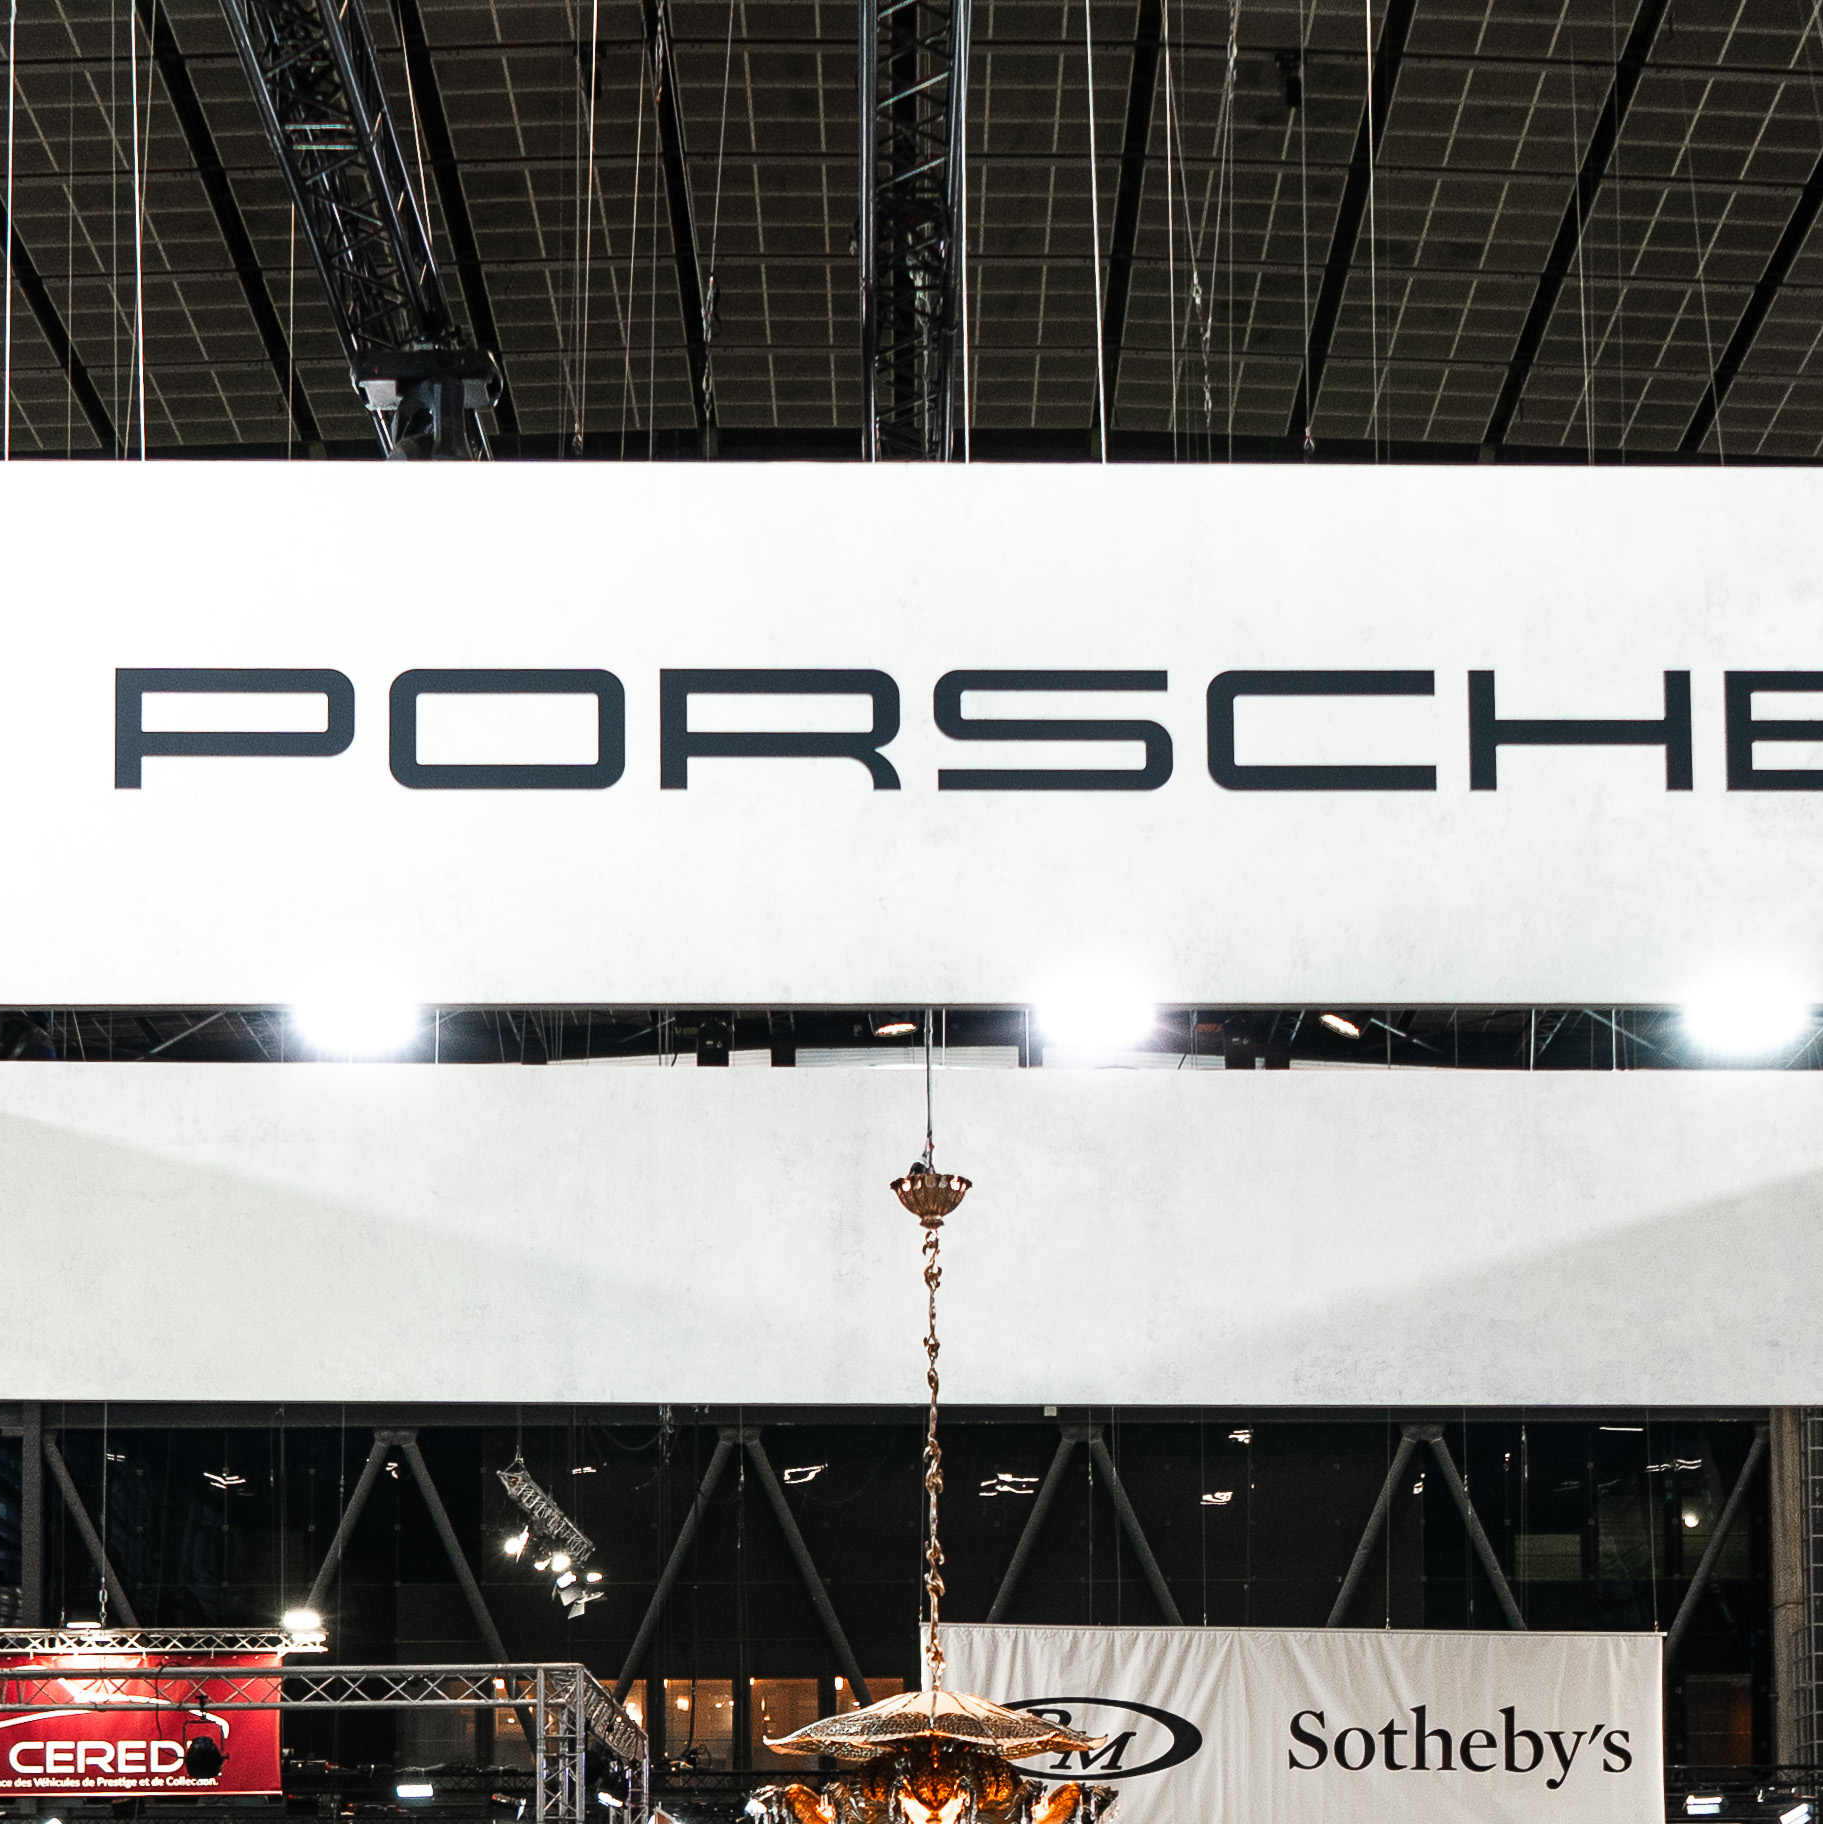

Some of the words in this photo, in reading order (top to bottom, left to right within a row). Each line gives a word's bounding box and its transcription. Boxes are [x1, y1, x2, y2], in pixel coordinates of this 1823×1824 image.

[9, 1740, 222, 1774] CERED
[1287, 1704, 1633, 1790] Sotheby's
[14, 1777, 32, 1788] des
[33, 1776, 81, 1788] Véhicules
[82, 1777, 95, 1788] de
[97, 1776, 137, 1789] Prestige
[139, 1777, 151, 1787] et
[151, 1776, 165, 1787] de
